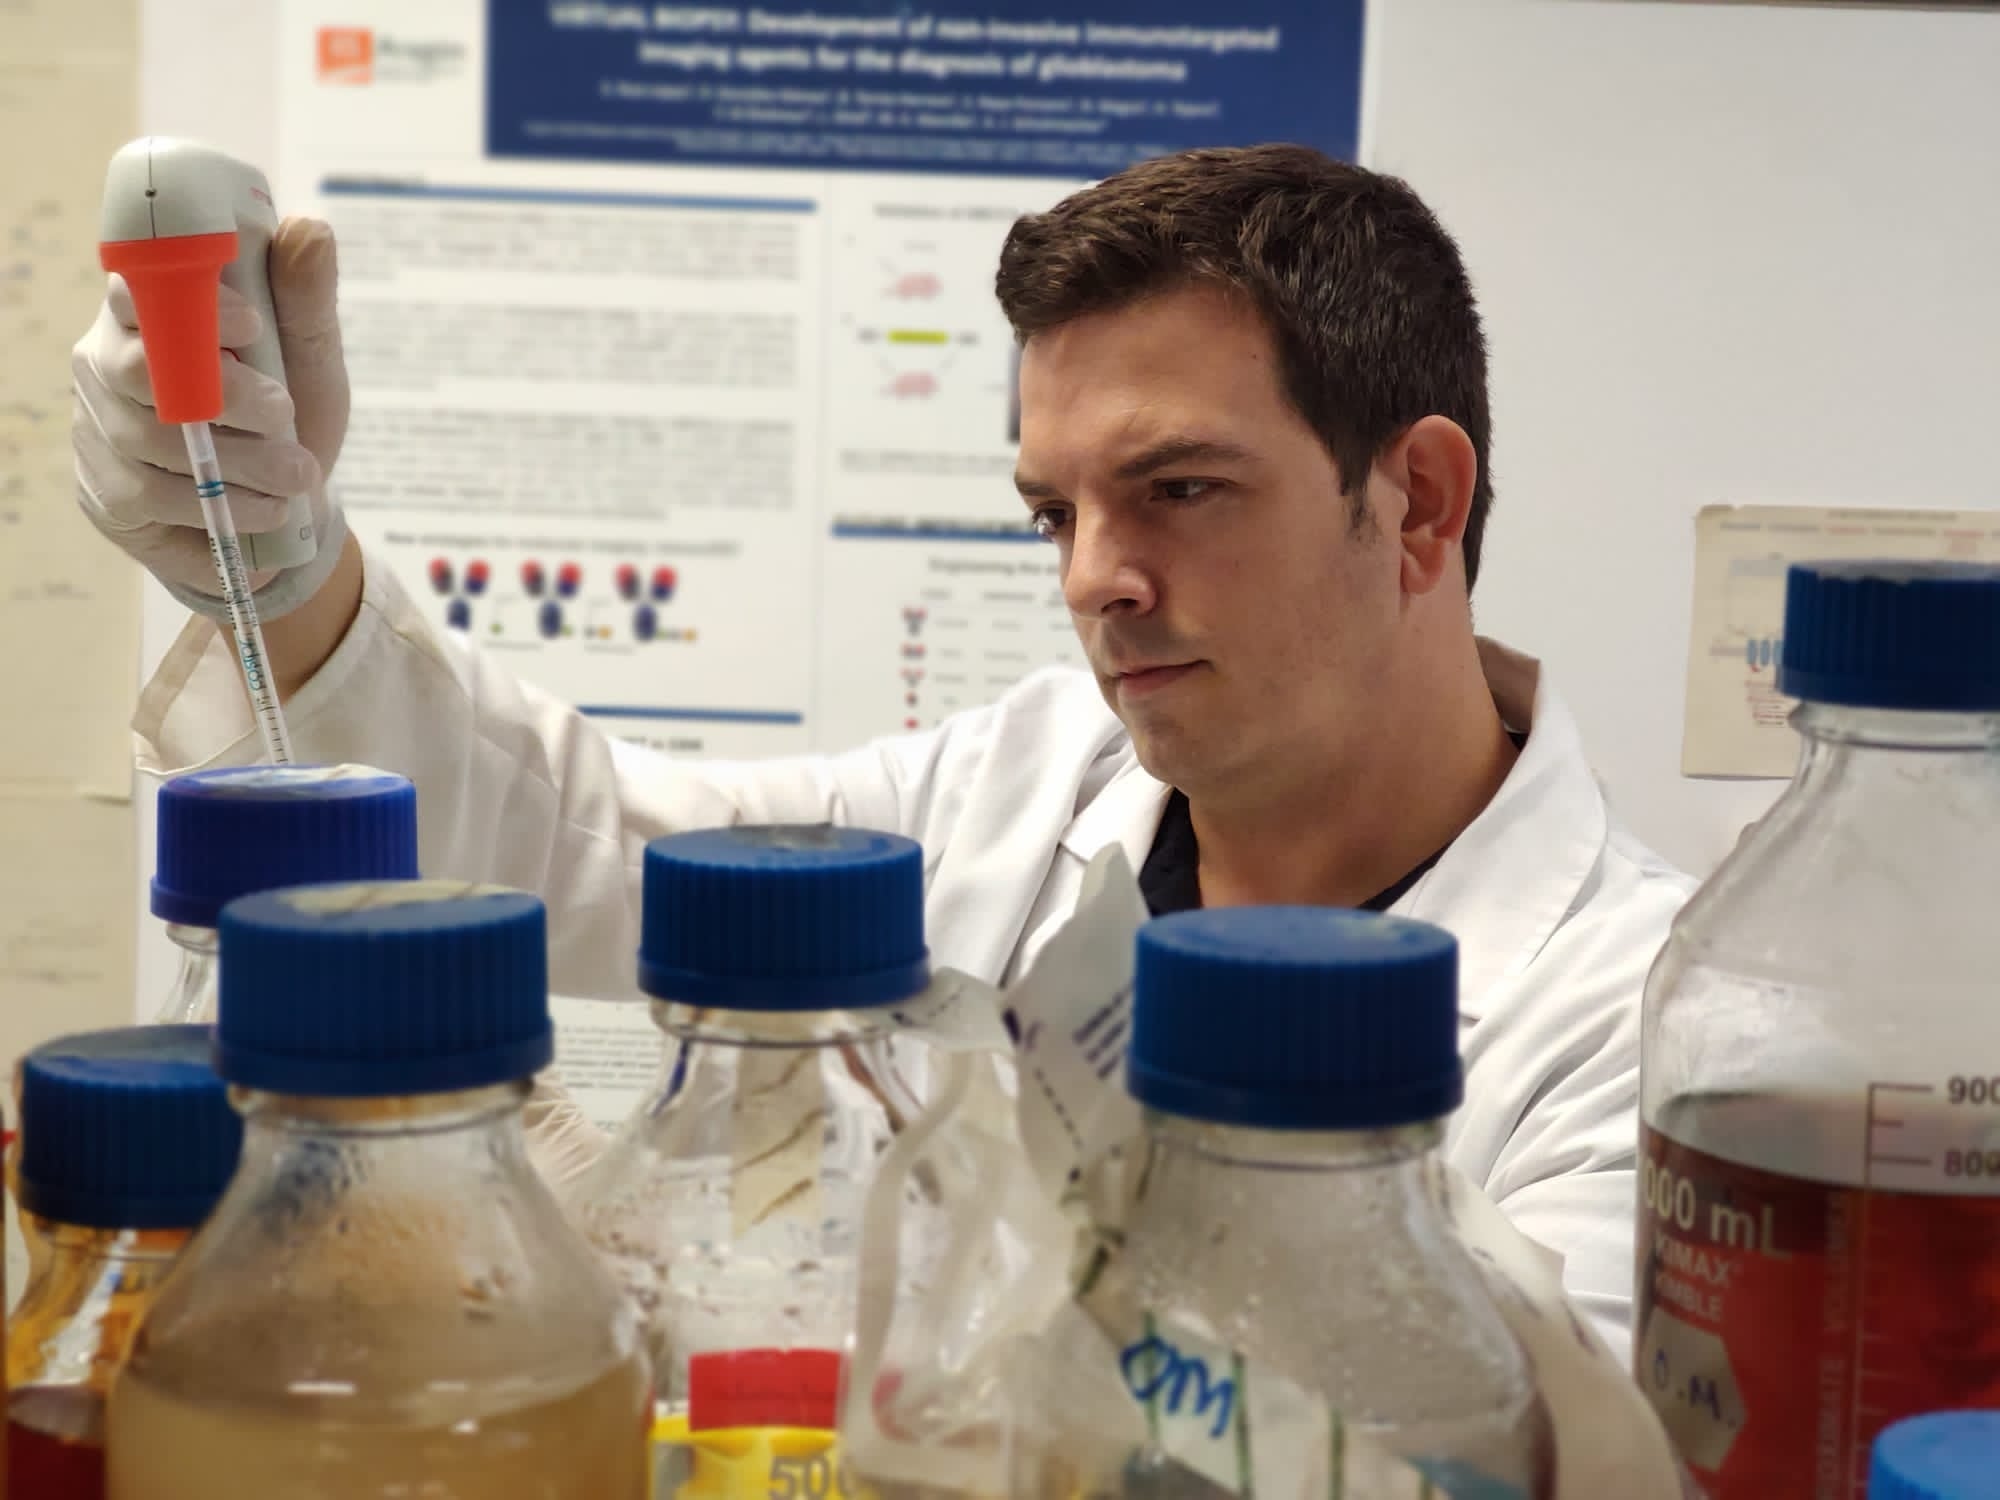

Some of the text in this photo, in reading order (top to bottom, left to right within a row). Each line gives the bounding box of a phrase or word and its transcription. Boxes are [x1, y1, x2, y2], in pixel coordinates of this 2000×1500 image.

[748, 11, 900, 41] Development
[908, 16, 931, 40] of
[1086, 23, 1280, 54] immunotargeted
[737, 47, 811, 72] agents
[816, 47, 847, 69] for
[855, 48, 892, 71] the
[899, 49, 1003, 78] diagnosis
[1010, 53, 1035, 76] of
[1039, 54, 1187, 82] glioblastoma
[1711, 1202, 1793, 1264] mL
